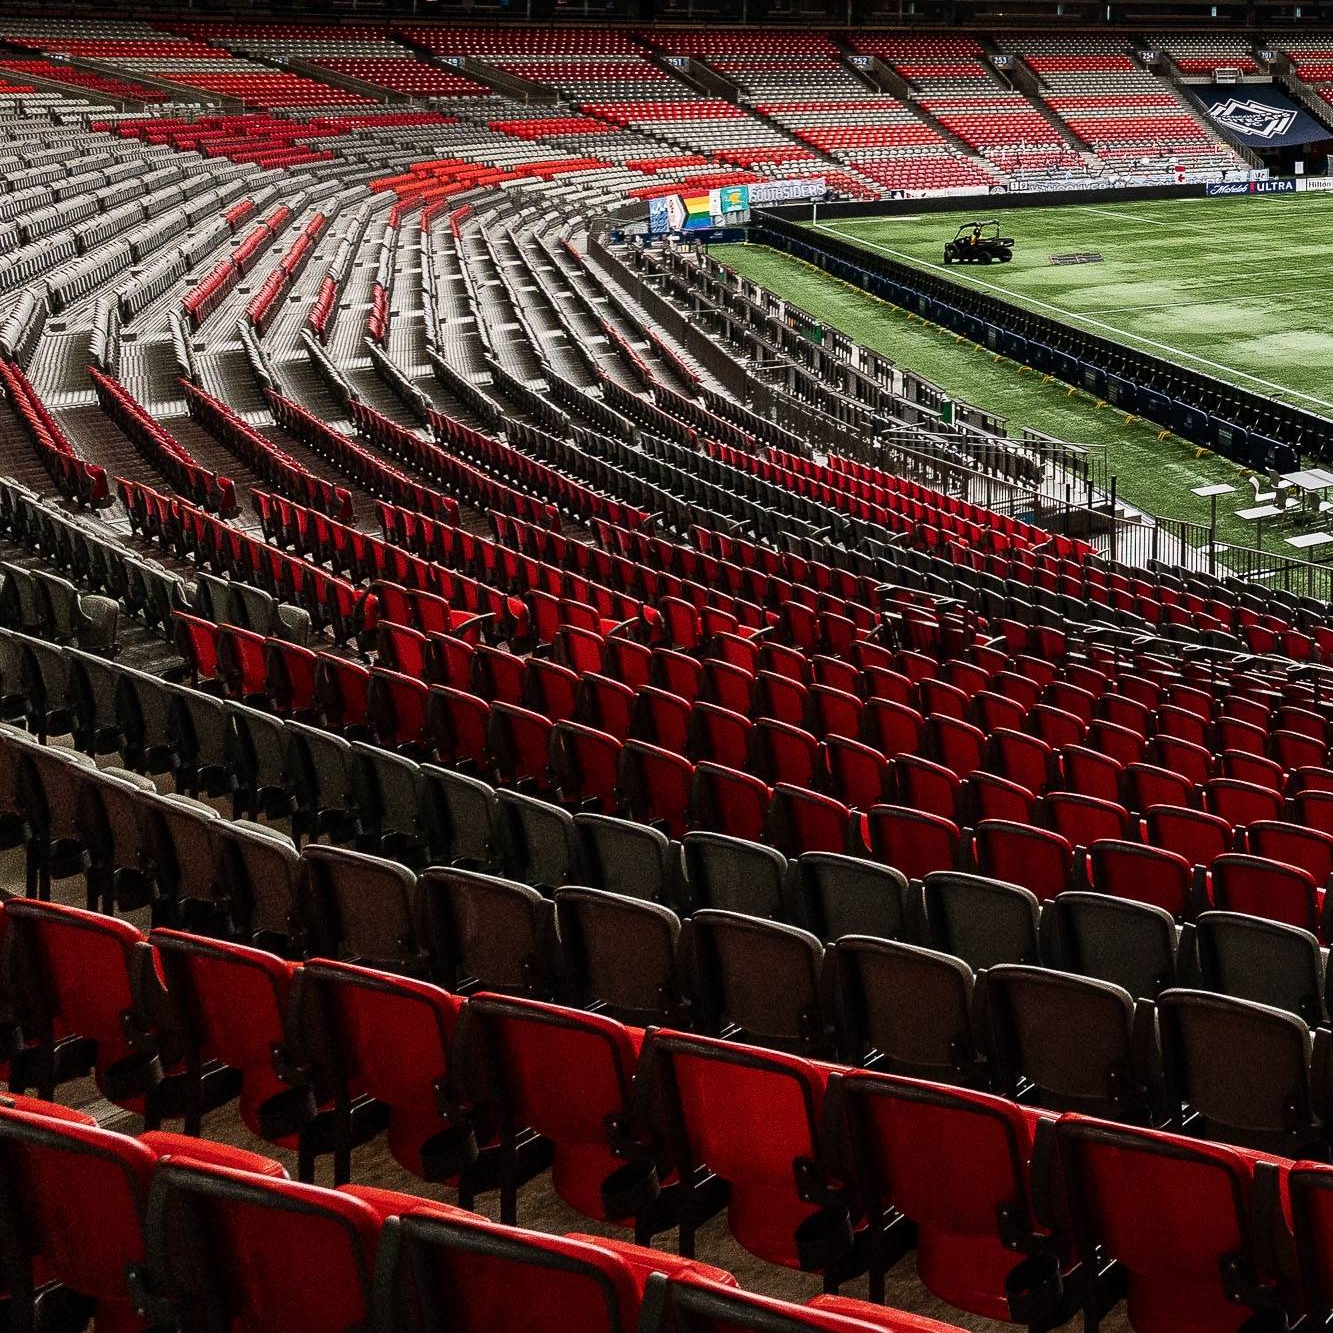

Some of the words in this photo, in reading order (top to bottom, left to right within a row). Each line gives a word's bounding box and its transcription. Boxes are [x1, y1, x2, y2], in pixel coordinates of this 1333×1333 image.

[993, 56, 1007, 64] 253
[1142, 51, 1154, 60] 254
[853, 57, 867, 66] 252
[1256, 181, 1293, 192] ULTRA
[1309, 179, 1332, 189] Hilton
[750, 183, 826, 203] SOUTHSIDERS
